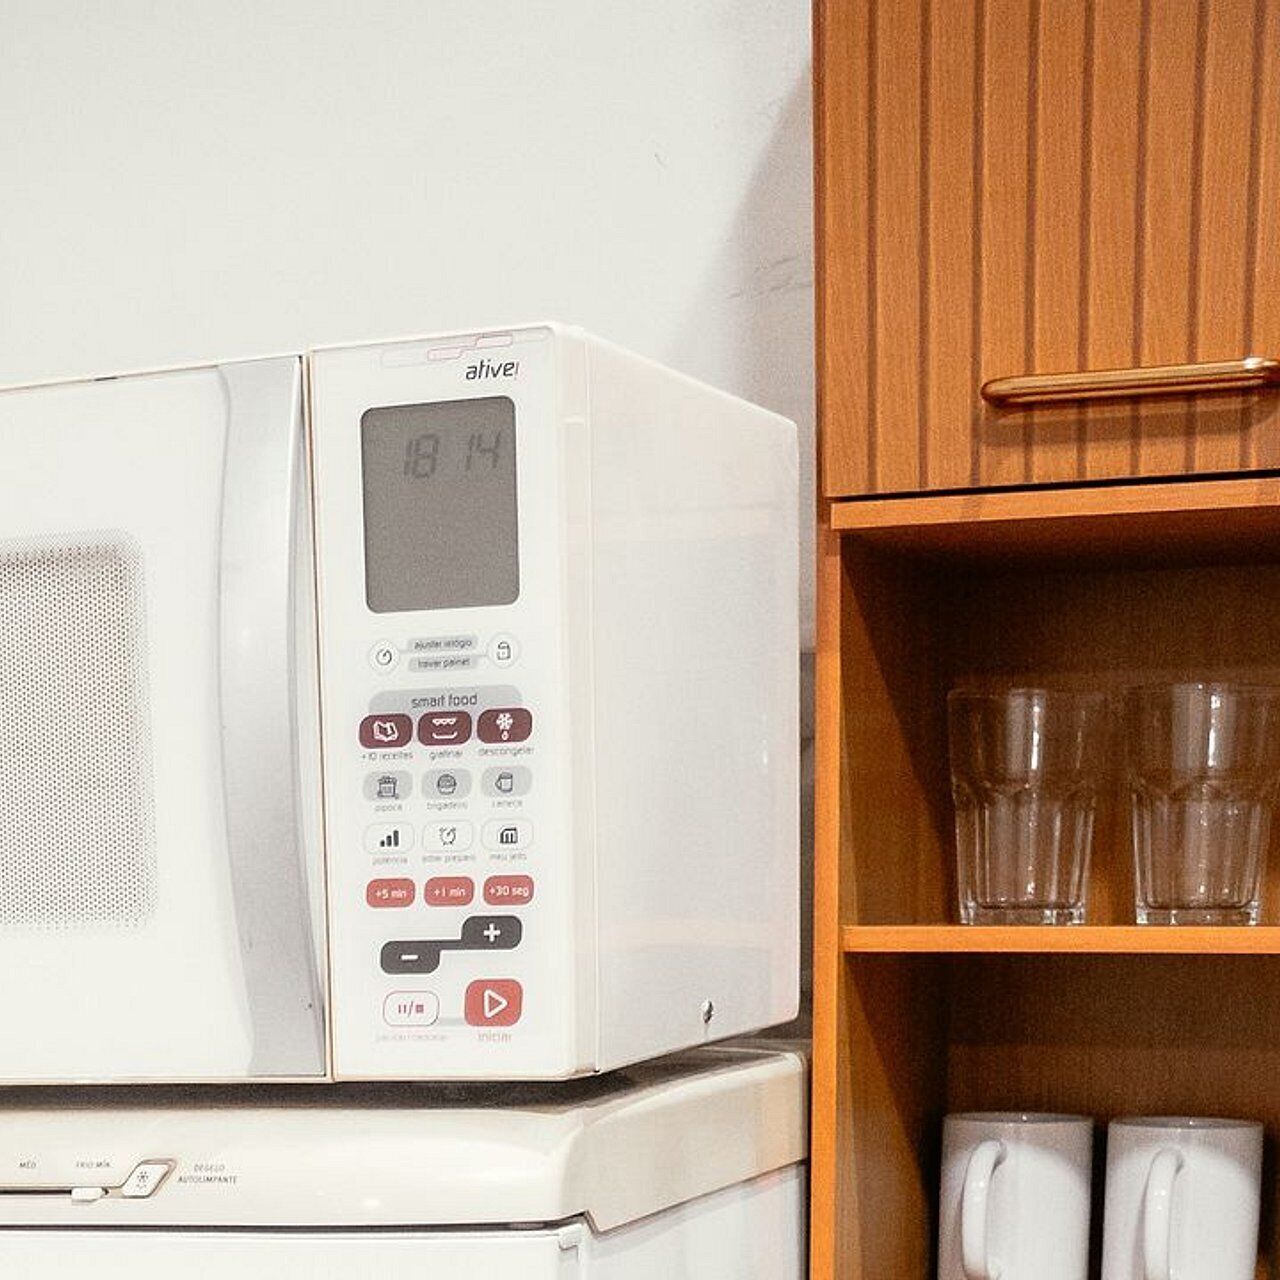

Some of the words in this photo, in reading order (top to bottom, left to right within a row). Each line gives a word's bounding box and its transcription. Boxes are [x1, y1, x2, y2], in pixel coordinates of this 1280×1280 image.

[411, 695, 445, 708] smart
[448, 693, 478, 706] food
[375, 889, 388, 899] +5
[391, 888, 407, 898] min
[433, 887, 446, 898] +1
[449, 887, 466, 897] min
[488, 886, 509, 896] +30
[511, 886, 529, 897] seg
